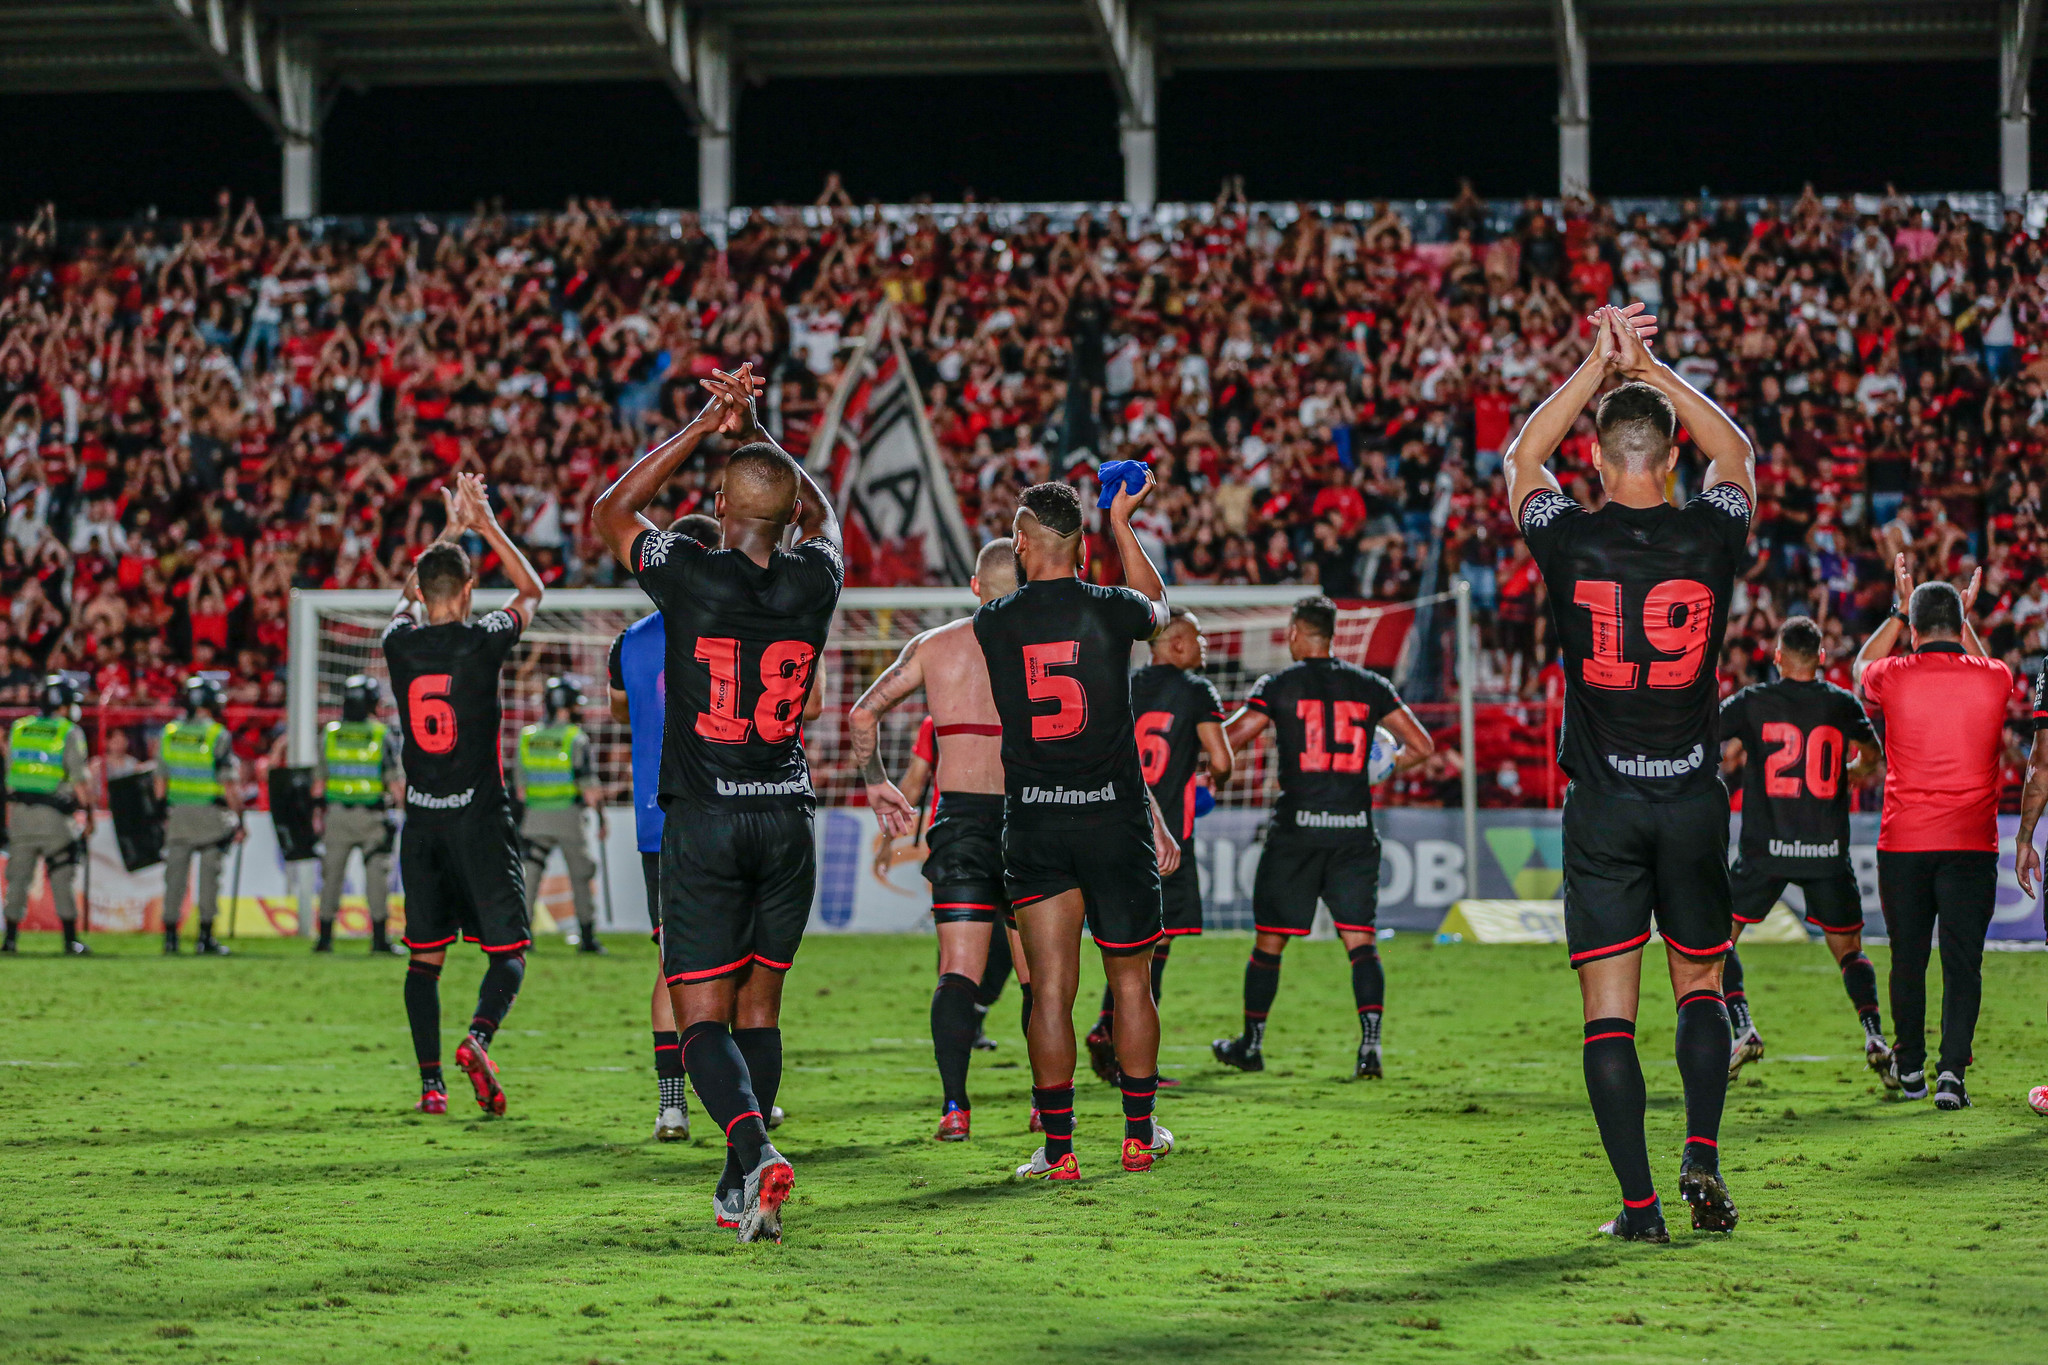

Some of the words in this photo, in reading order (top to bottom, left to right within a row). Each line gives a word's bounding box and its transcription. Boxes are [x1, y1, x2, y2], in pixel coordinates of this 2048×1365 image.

[1573, 578, 1715, 691] 19
[408, 674, 458, 754] 6
[693, 636, 816, 744] 18
[1022, 640, 1088, 741] 5
[1296, 699, 1370, 774] 15
[1761, 722, 1844, 800] 20
[1021, 781, 1116, 804] Unimed
[1296, 810, 1368, 828] Unimed
[1768, 838, 1840, 858] Unimed
